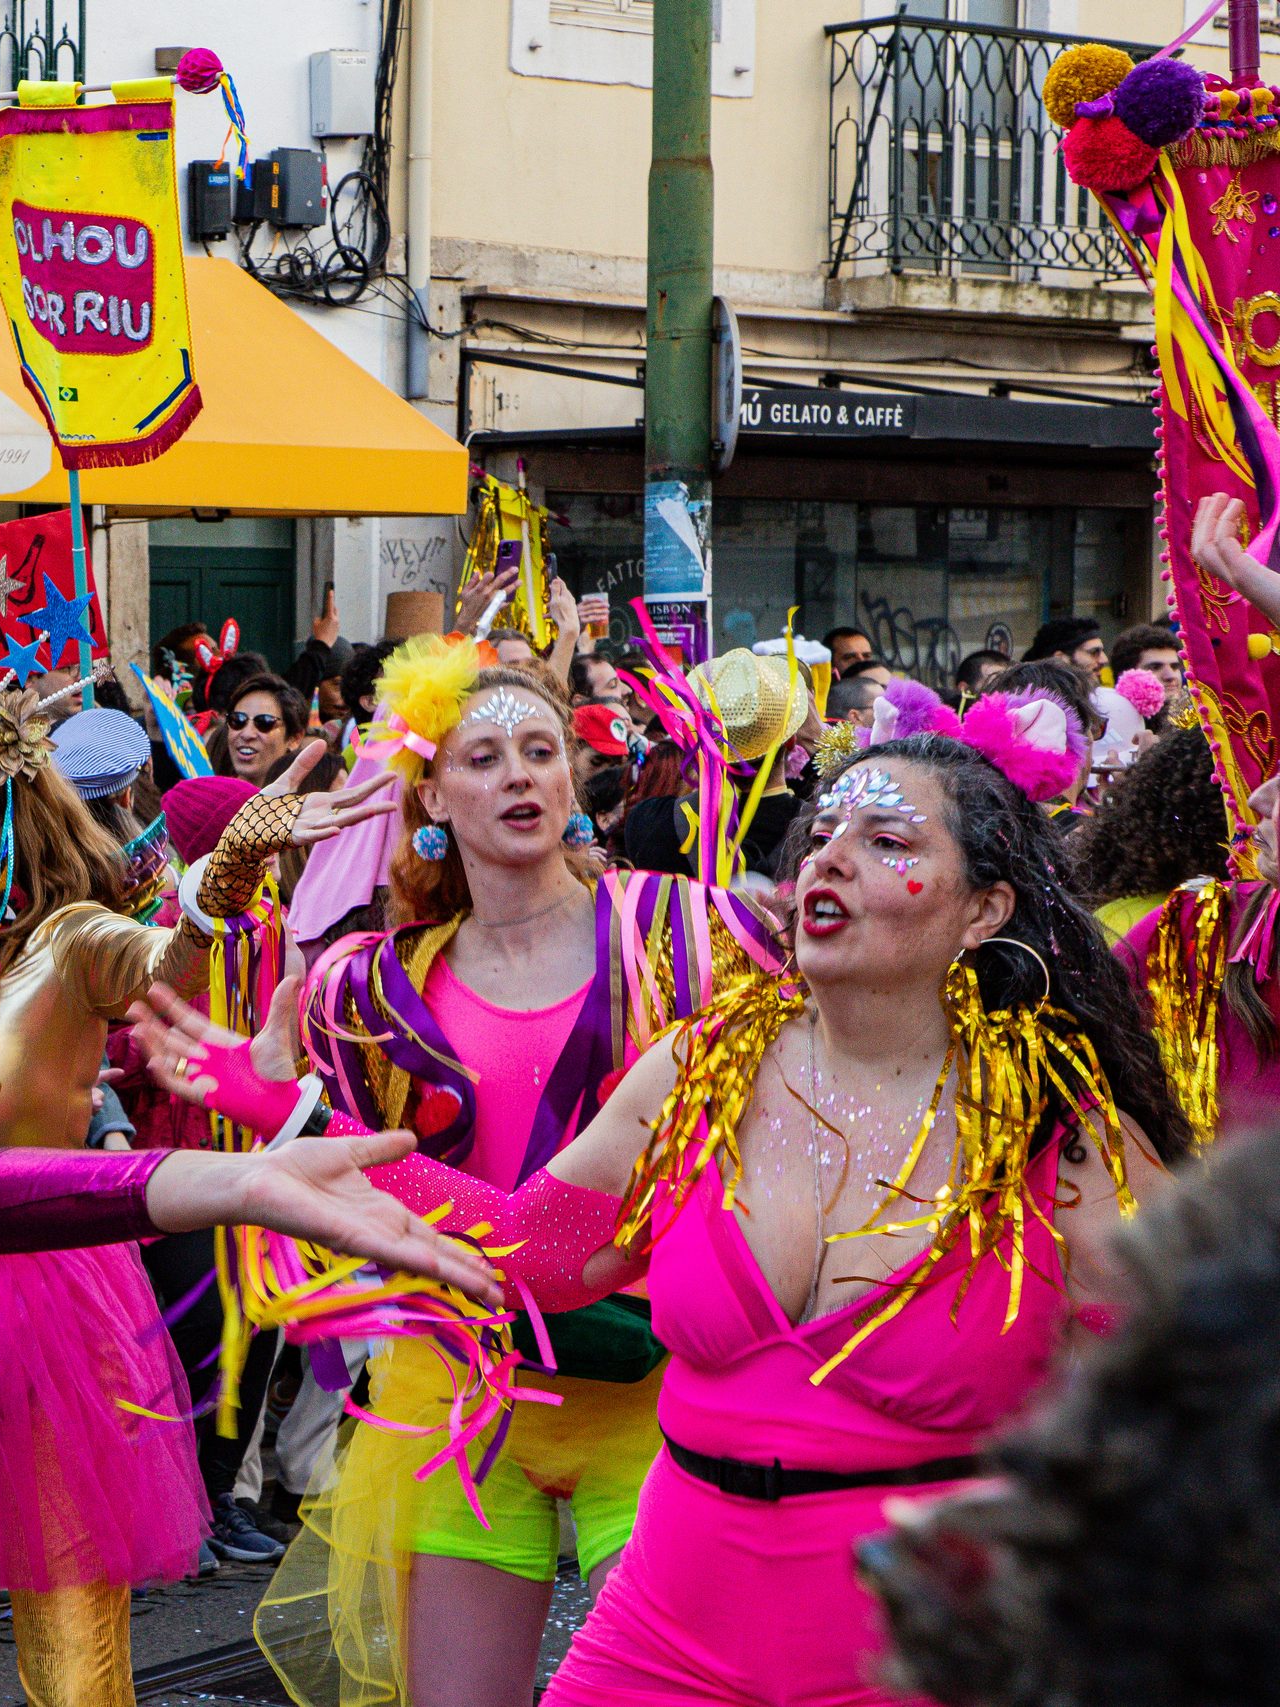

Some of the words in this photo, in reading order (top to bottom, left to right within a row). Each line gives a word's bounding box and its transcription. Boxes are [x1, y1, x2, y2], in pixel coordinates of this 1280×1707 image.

[13, 217, 149, 269] OLHOU
[770, 403, 832, 425] GELATO
[836, 405, 849, 425] &
[854, 404, 903, 427] CAFFÈ
[649, 603, 691, 614] LISBON
